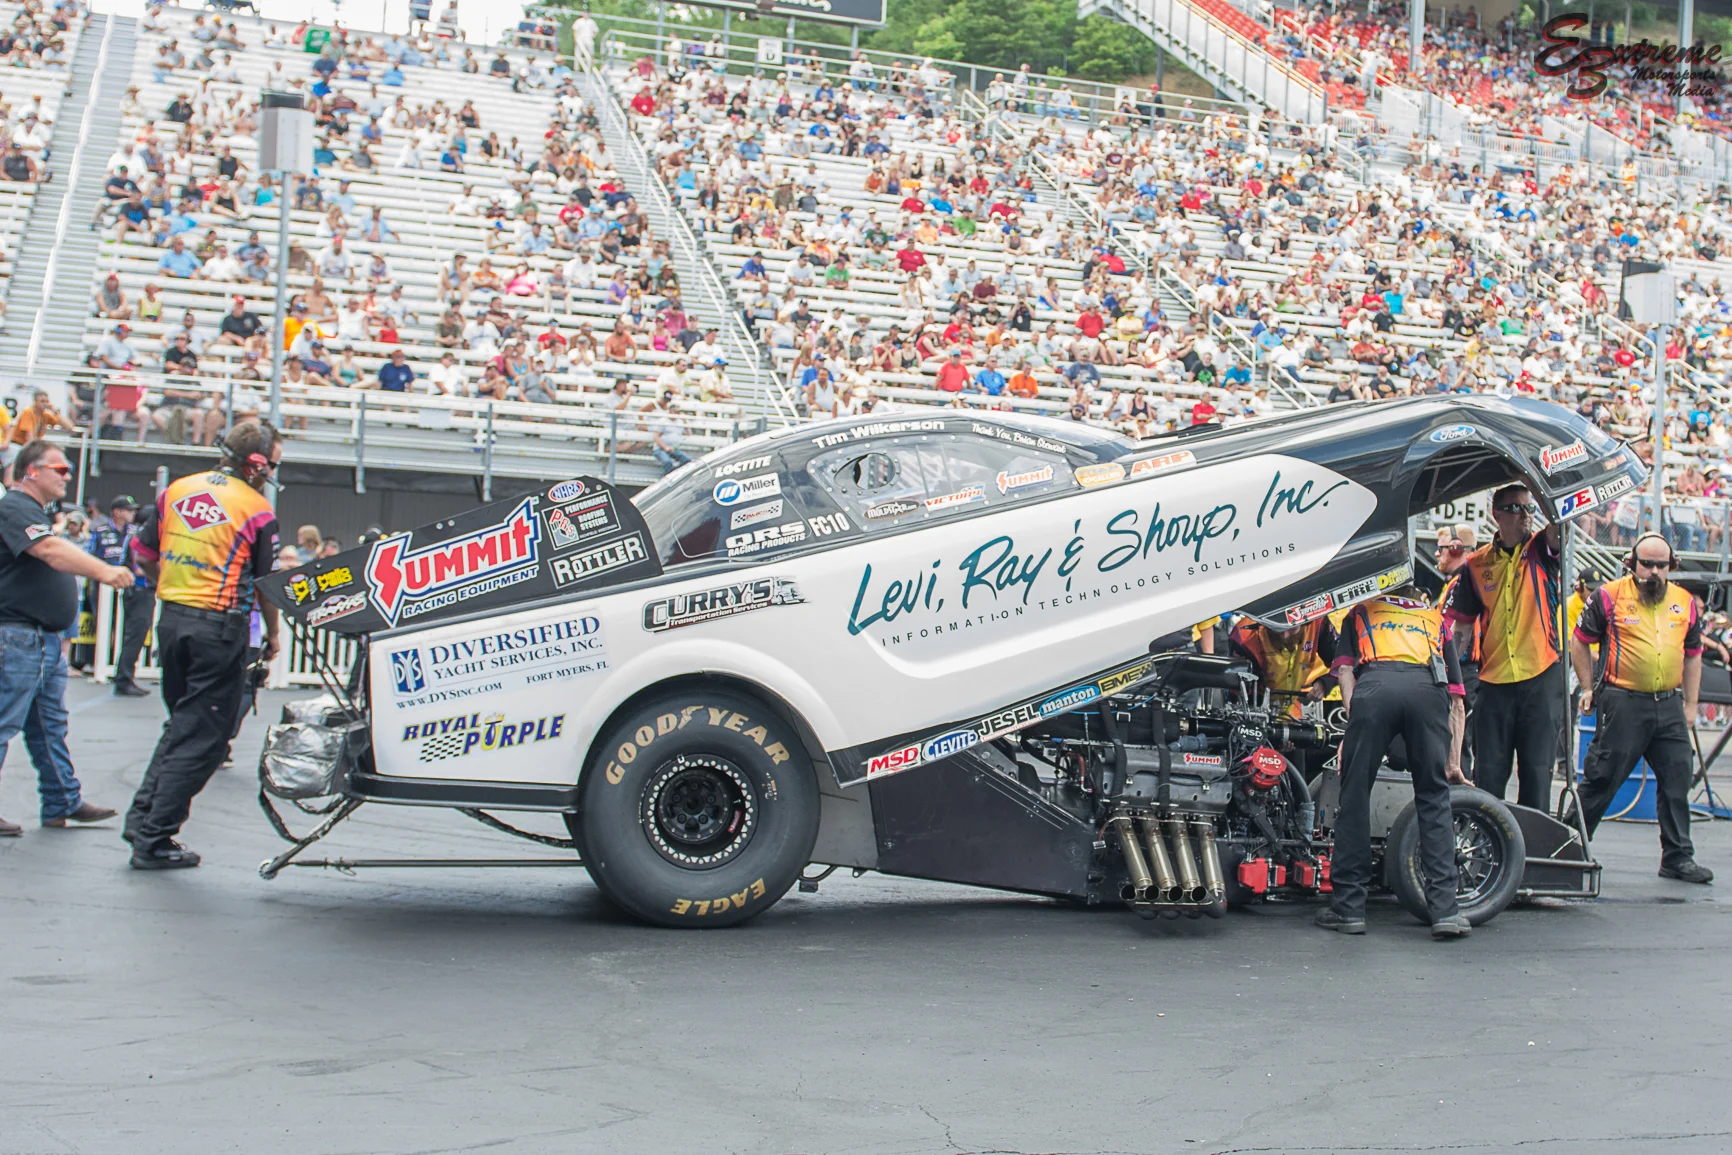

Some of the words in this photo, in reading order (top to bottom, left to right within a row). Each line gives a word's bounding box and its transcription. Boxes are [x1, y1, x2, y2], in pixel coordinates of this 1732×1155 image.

[811, 432, 849, 449] Tim
[849, 419, 945, 440] Wilkerson
[1437, 427, 1470, 442] Ford
[714, 455, 773, 479] LOCTITE
[1132, 451, 1191, 473] ARP
[553, 482, 581, 499] NHRA
[742, 478, 776, 493] Miller
[181, 498, 222, 524] LRS
[564, 494, 609, 515] PERFORMANCE
[577, 508, 606, 523] ROOFING
[1561, 488, 1592, 517] JE
[580, 515, 609, 531] SYSTEMS
[809, 512, 850, 538] FC10
[727, 543, 760, 557] RACING
[760, 533, 806, 552] PRODUCTS
[846, 562, 944, 637] Levi,
[959, 534, 1052, 607] Ray
[1057, 518, 1086, 591] &
[1098, 502, 1240, 572] Shoup,
[1256, 470, 1350, 528] Inc.
[553, 536, 644, 584] ROTTLER
[402, 592, 457, 618] RACING
[456, 566, 539, 602] EQUIPMENT
[643, 577, 773, 631] CURRY'S
[882, 605, 1025, 648] INFORMATION
[1038, 572, 1174, 611] TECHNOLOGY
[1187, 541, 1298, 577] SOLUTIONS
[1337, 583, 1376, 604] FIRE
[669, 607, 733, 627] Transportation
[732, 601, 769, 615] Services
[429, 616, 601, 666] DIVERSIFIED
[432, 660, 488, 680] YACHT
[490, 645, 568, 669] SERVICES,
[571, 637, 604, 653] INC.
[525, 670, 553, 685] FORT
[556, 664, 595, 679] MYERS,
[596, 660, 609, 670] FL
[1100, 667, 1141, 693] BME
[1041, 687, 1096, 714] manton
[402, 711, 482, 742] ROYAL
[979, 705, 1040, 737] JESEL
[1239, 727, 1263, 739] MSD
[461, 712, 567, 757] PURPLE
[923, 731, 977, 760] CLEVITE
[869, 747, 919, 774] MSD
[1258, 756, 1282, 767] MSD
[669, 877, 767, 917] EAGLE
